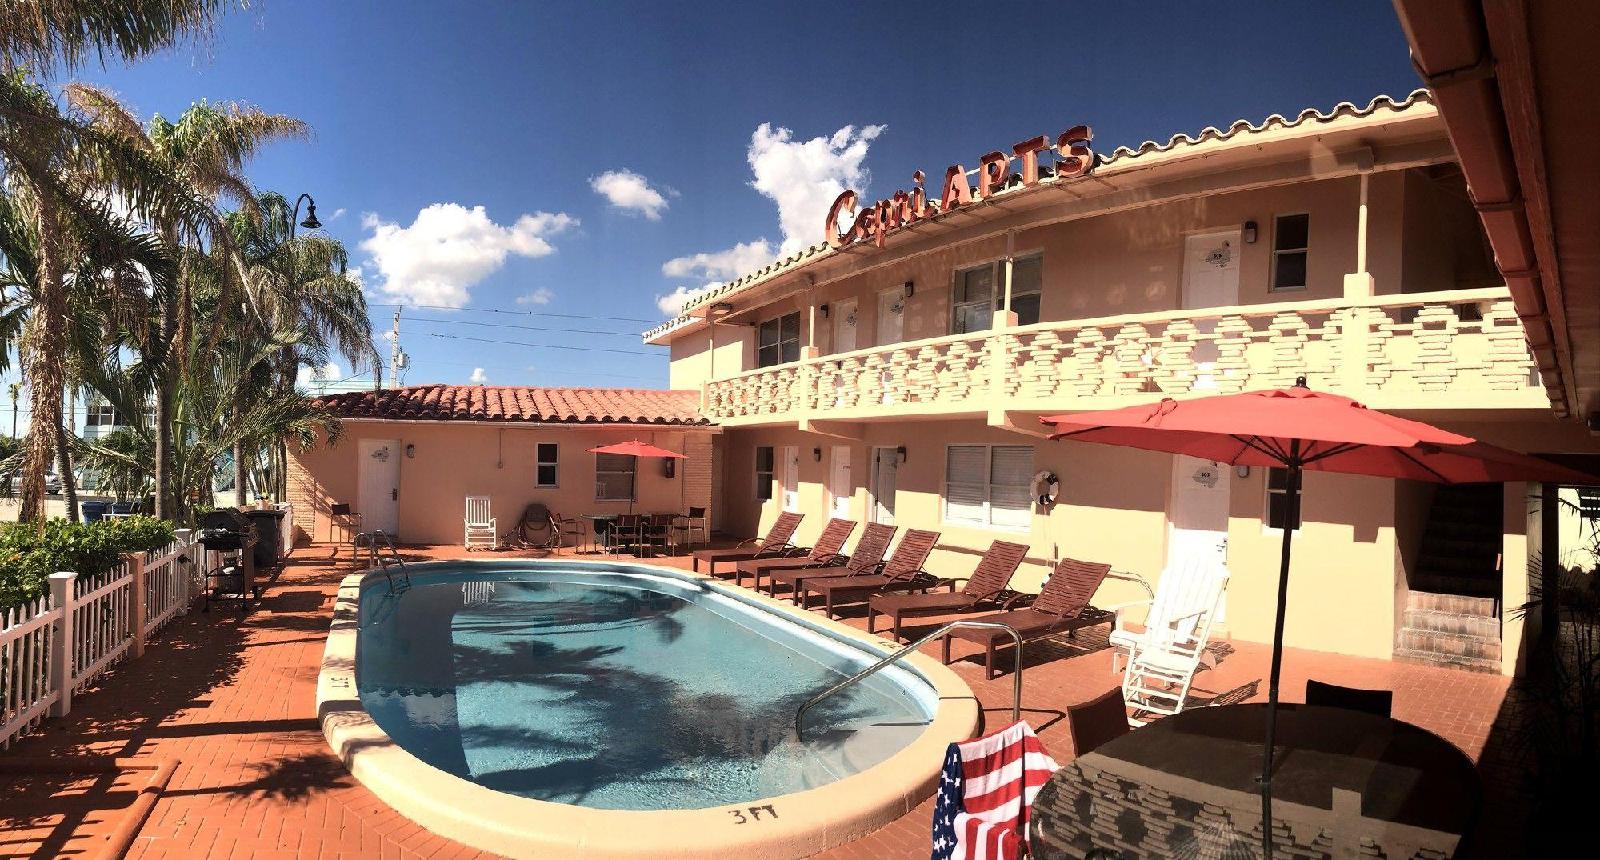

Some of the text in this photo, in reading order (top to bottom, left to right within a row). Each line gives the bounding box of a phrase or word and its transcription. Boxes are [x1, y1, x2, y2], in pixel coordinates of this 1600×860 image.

[825, 125, 1094, 248] Capri APTS
[728, 810, 747, 824] 3
